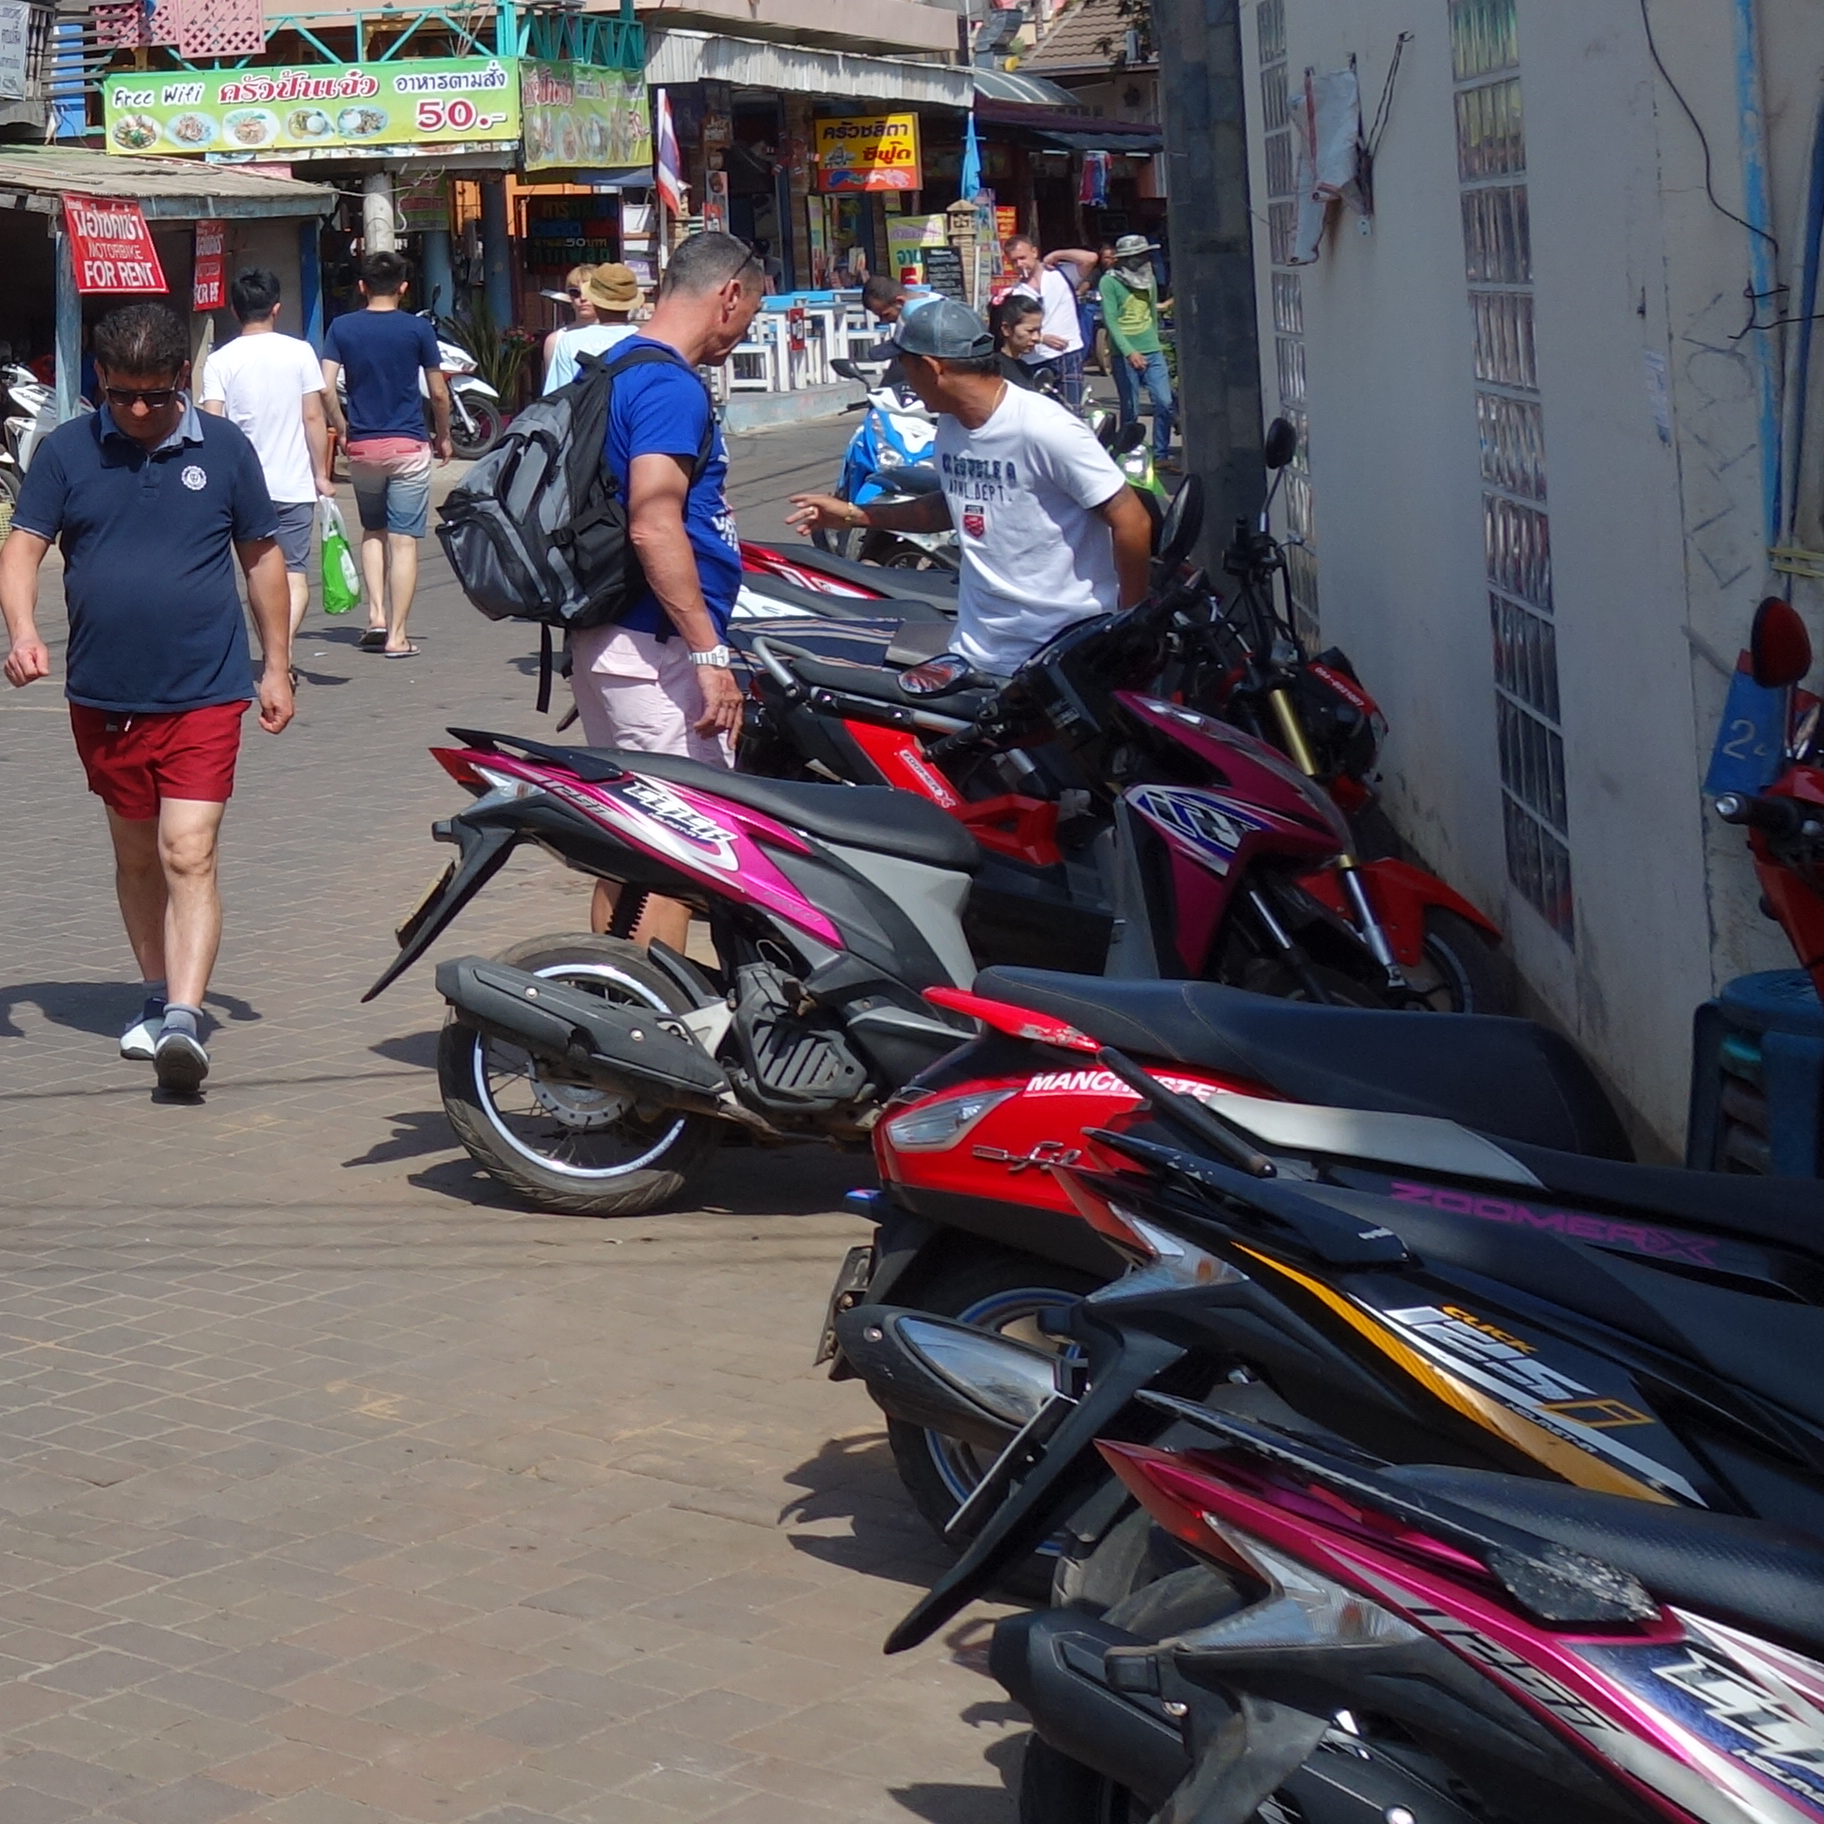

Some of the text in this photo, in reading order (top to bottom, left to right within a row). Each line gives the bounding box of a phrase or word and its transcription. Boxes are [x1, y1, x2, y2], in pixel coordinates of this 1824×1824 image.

[394, 63, 506, 92] อาหารตามสั่ง
[84, 261, 155, 286] FOR RENT
